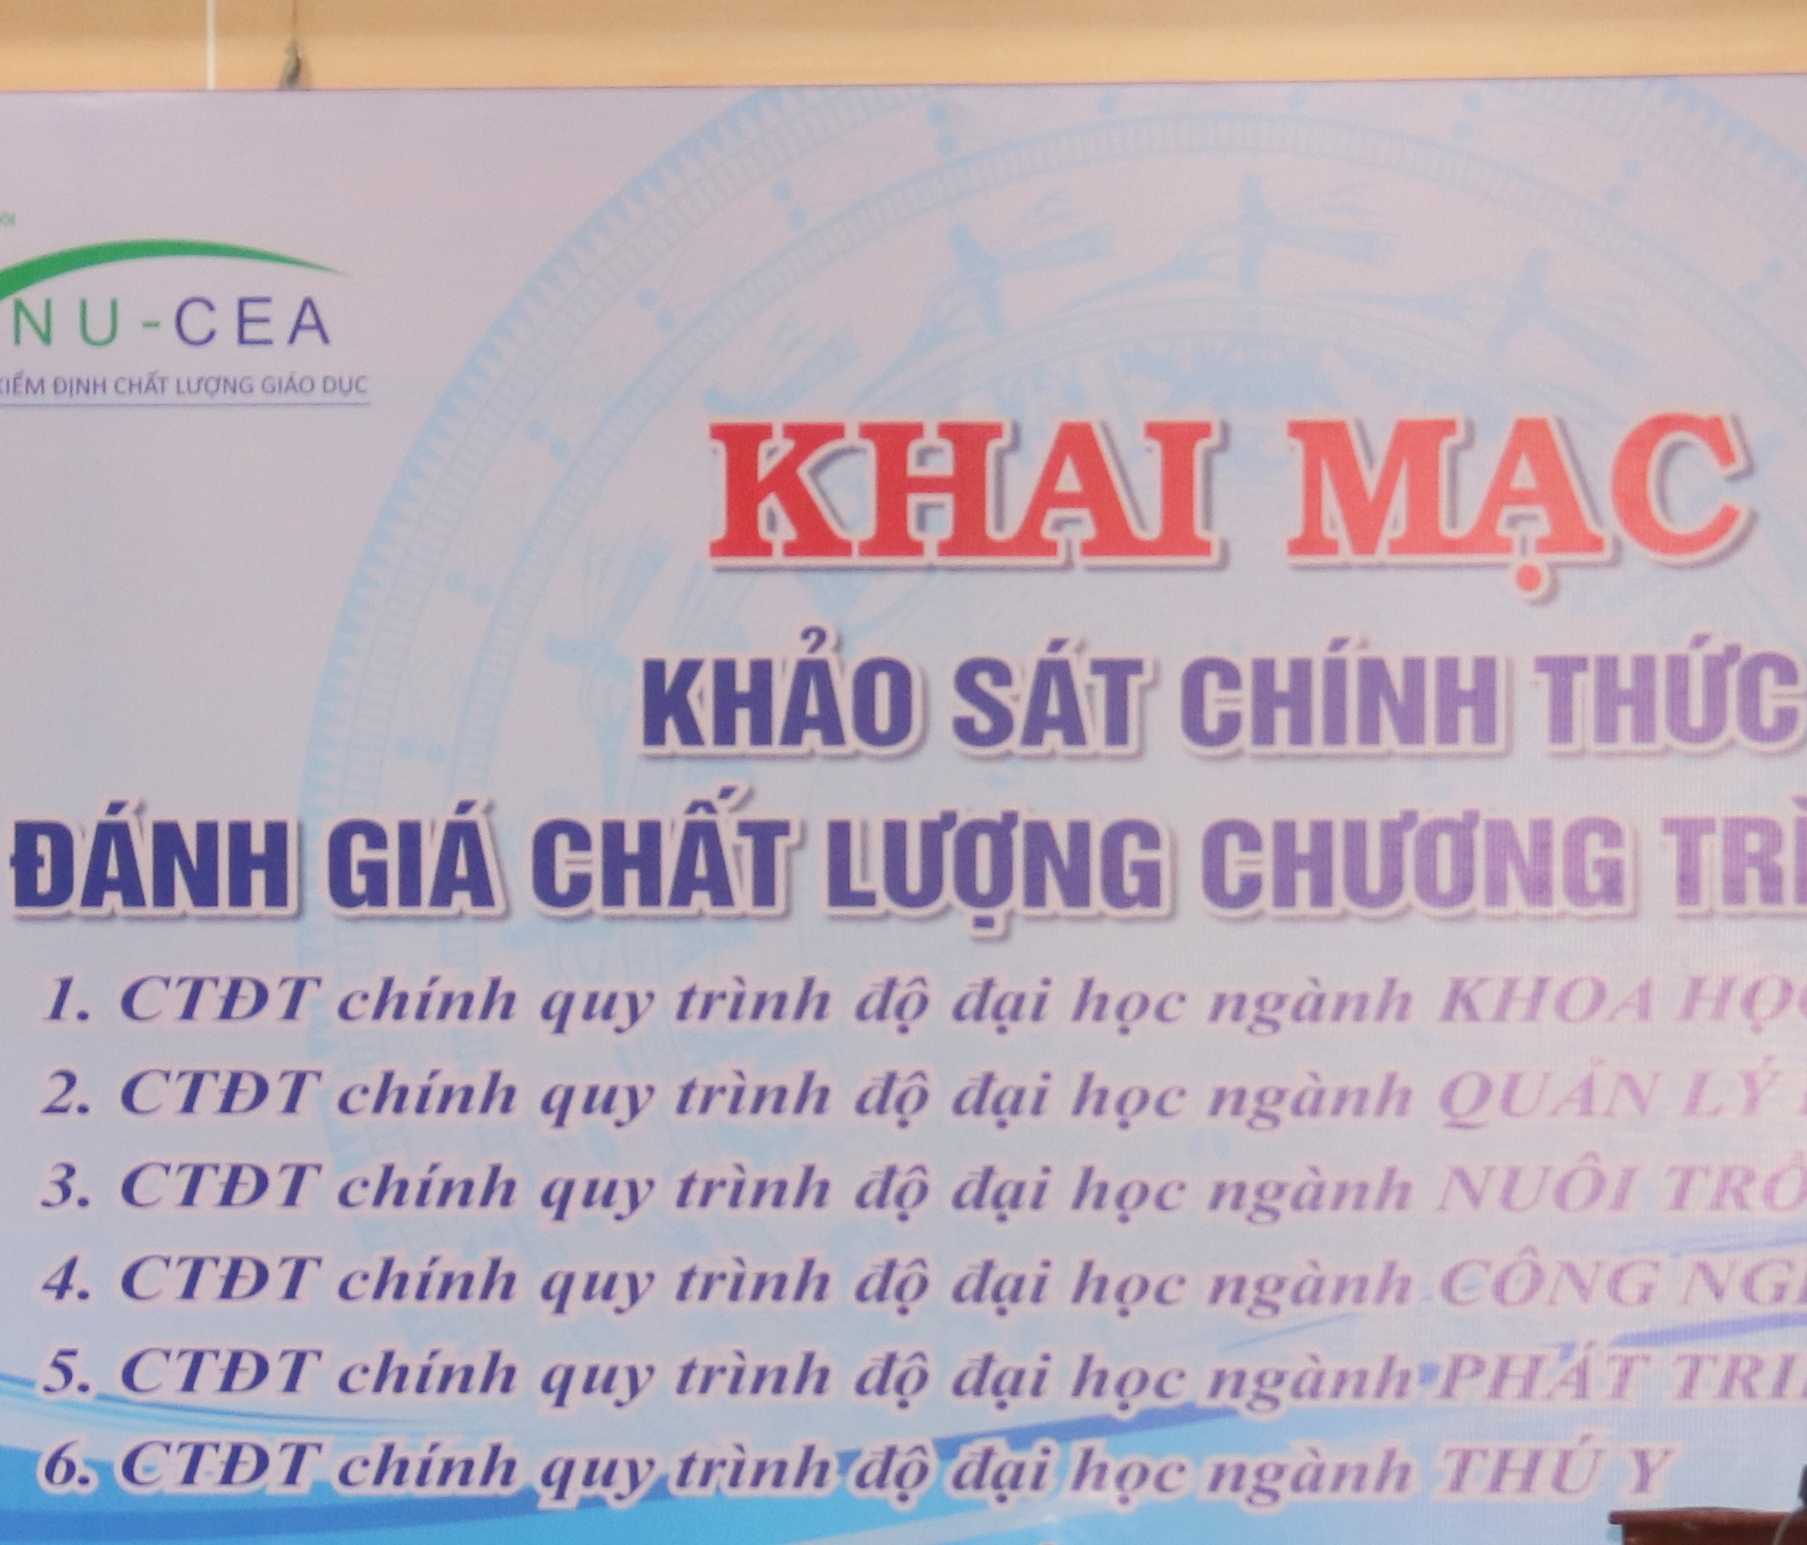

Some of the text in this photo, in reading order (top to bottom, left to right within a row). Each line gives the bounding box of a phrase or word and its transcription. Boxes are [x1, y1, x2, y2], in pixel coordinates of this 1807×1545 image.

[53, 375, 106, 398] ĐỊNH
[114, 370, 169, 396] CHẤT
[176, 375, 254, 399] LƯỢNG
[261, 371, 315, 396] GIÁO
[323, 375, 369, 398] DỤC
[708, 411, 1743, 594] KHAI MẠC
[641, 627, 1803, 748] KHẢO SÁT CHÍNH THỨC
[10, 801, 291, 908] ĐÁNH
[329, 801, 496, 908] GIÁ
[531, 784, 795, 908] CHẤT
[827, 809, 1162, 928] LƯỢNG
[1201, 807, 1626, 908] CHƯƠNG
[41, 976, 91, 1022] 1.
[119, 976, 322, 1022] CTĐT
[337, 976, 516, 1022] chính
[540, 989, 656, 1035] quy
[675, 977, 830, 1022] trình
[854, 977, 929, 1036] độ
[951, 977, 1051, 1036] đại
[1071, 978, 1187, 1036] học
[1207, 978, 1412, 1037] ngành
[1437, 972, 1666, 1023] KHOA
[41, 1069, 91, 1115] 2.
[119, 1069, 322, 1115] CTĐT
[337, 1069, 516, 1115] chính
[540, 1082, 656, 1128] quy
[675, 1070, 830, 1115] trình
[854, 1070, 929, 1129] độ
[951, 1070, 1051, 1129] đại
[1071, 1071, 1187, 1129] học
[1207, 1071, 1412, 1130] ngành
[41, 1162, 91, 1208] 3.
[119, 1162, 322, 1208] CTĐT
[337, 1162, 516, 1208] chính
[540, 1175, 656, 1221] quy
[675, 1163, 830, 1208] trình
[854, 1163, 929, 1222] độ
[951, 1163, 1051, 1222] đại
[1071, 1164, 1187, 1222] học
[1207, 1164, 1412, 1223] ngành
[1433, 1151, 1640, 1212] NUÔI
[41, 1255, 91, 1301] 4.
[119, 1255, 322, 1301] CTĐT
[337, 1255, 516, 1301] chính
[540, 1268, 656, 1314] quy
[675, 1256, 830, 1301] trình
[854, 1256, 929, 1315] độ
[951, 1256, 1051, 1315] đại
[1071, 1257, 1187, 1315] học
[1207, 1257, 1412, 1316] ngành
[1440, 1245, 1660, 1305] CÔNG
[41, 1348, 91, 1394] 5.
[119, 1348, 322, 1394] CTĐT
[337, 1348, 516, 1394] chính
[540, 1361, 656, 1407] quy
[675, 1349, 830, 1394] trình
[854, 1349, 929, 1408] độ
[951, 1349, 1051, 1408] đại
[1071, 1350, 1187, 1408] học
[1207, 1350, 1412, 1409] ngành
[1439, 1340, 1652, 1399] PHÁT
[41, 1433, 1675, 1502] 6. CTĐT chính quy trình độ đại học ngành THÚ Y
